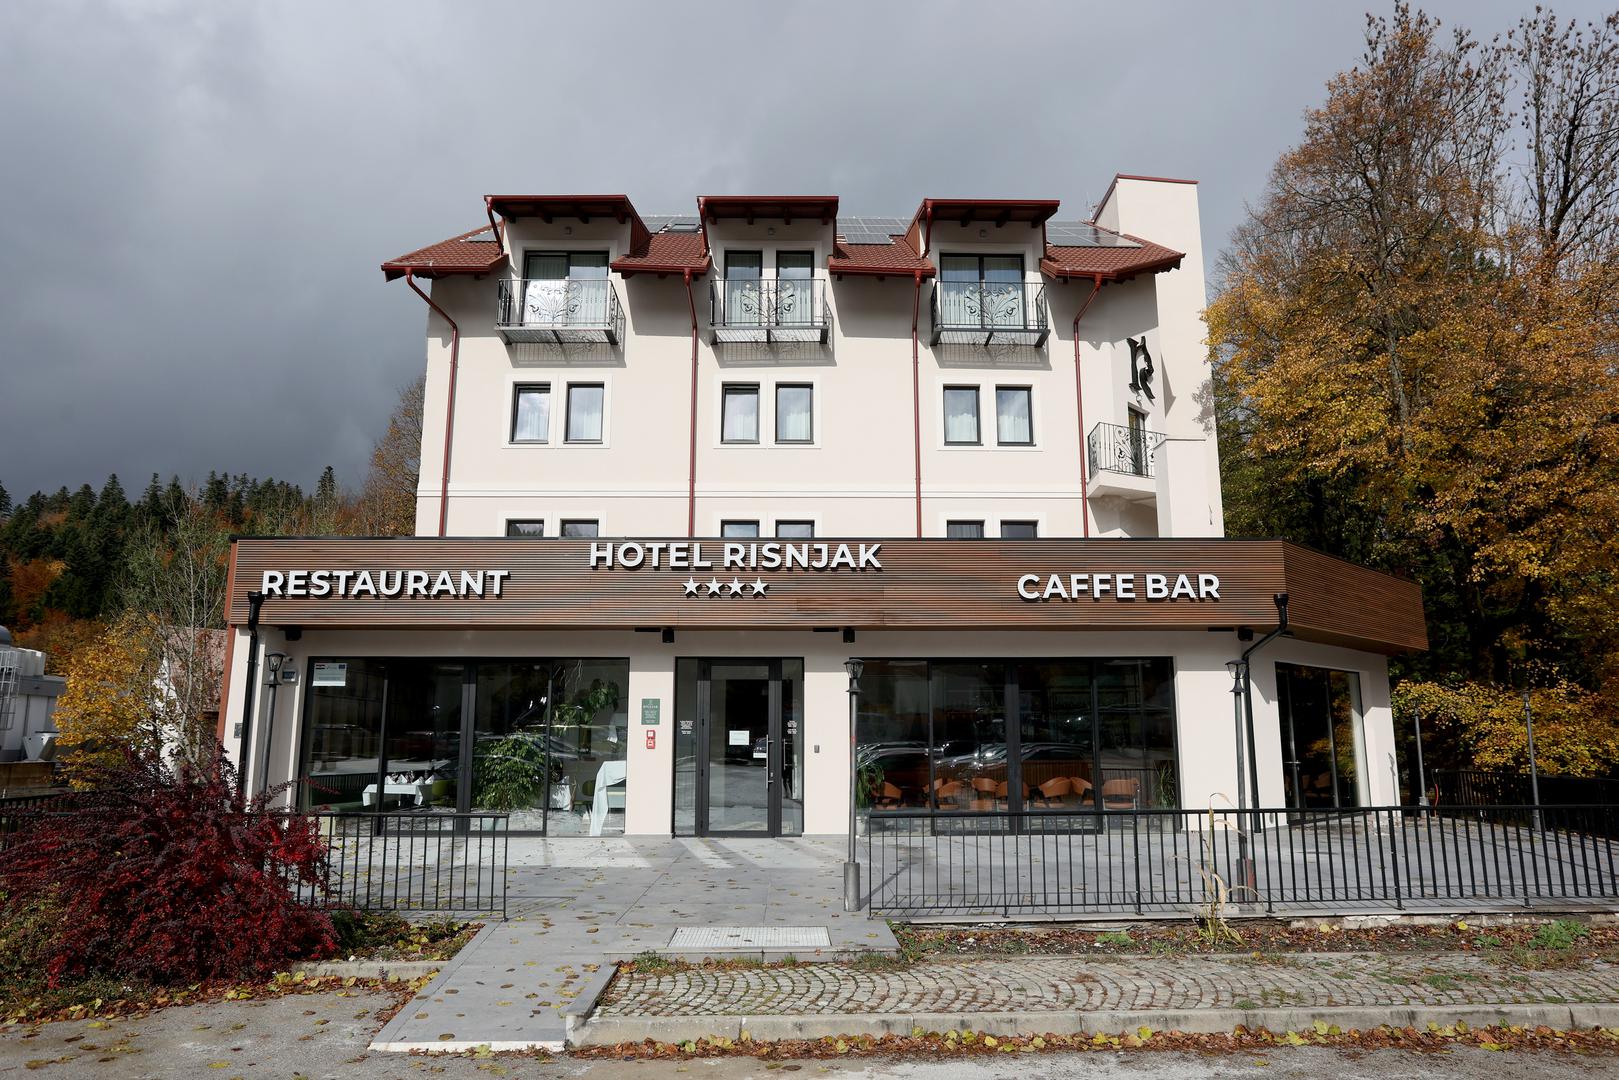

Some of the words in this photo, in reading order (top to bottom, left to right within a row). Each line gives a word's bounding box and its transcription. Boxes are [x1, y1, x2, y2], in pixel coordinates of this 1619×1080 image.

[589, 542, 712, 569] HOTEL
[723, 543, 883, 570] RISNJAK
[261, 570, 510, 597] RESTAURANT
[1016, 573, 1136, 600] CAFFE
[1145, 573, 1221, 600] BAR
